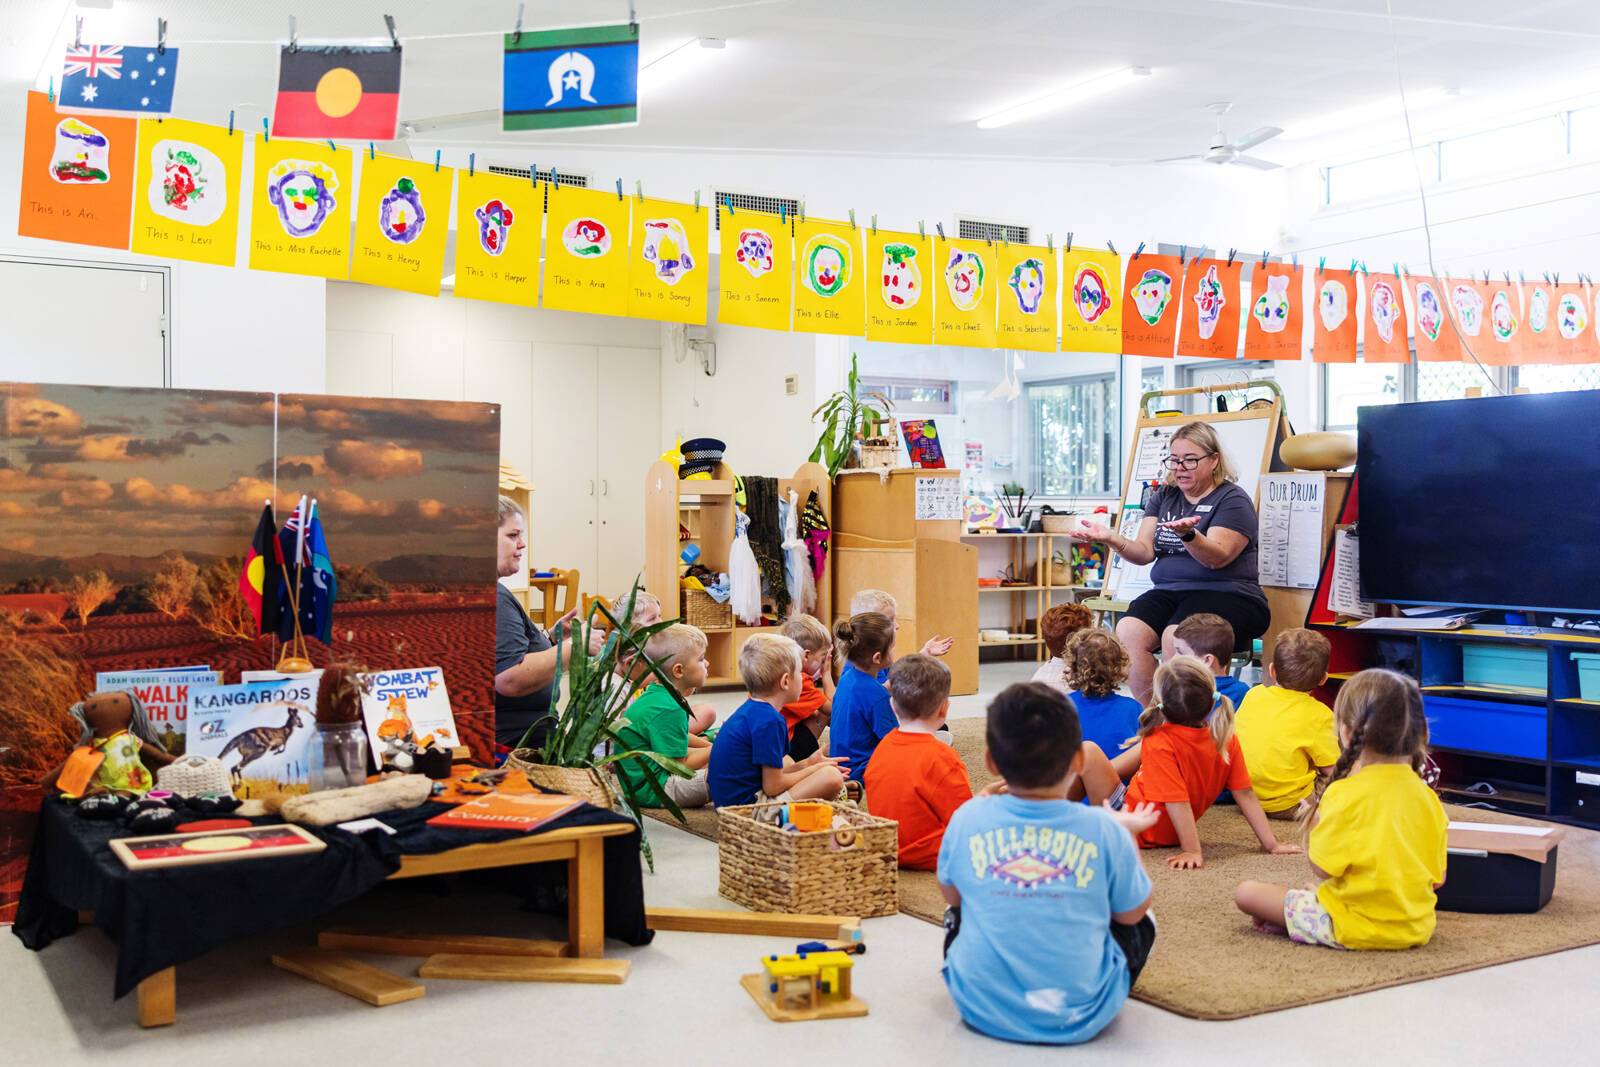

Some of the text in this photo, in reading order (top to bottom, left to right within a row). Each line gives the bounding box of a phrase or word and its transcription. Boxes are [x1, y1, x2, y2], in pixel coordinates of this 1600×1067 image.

[30, 201, 53, 214] This
[62, 207, 71, 216] is
[146, 226, 168, 239] This
[191, 232, 212, 245] Levi
[256, 240, 271, 251] This
[276, 244, 283, 252] is
[363, 247, 381, 258] This
[398, 252, 420, 272] Henry
[464, 266, 484, 277] This
[553, 275, 570, 285] This
[634, 288, 652, 298] This
[670, 291, 691, 307] Sonny
[725, 290, 740, 300] This
[796, 308, 812, 318] This
[872, 315, 884, 326] This
[1269, 481, 1318, 502] OUR DRUM
[194, 687, 311, 709] KANGAROOS
[968, 825, 1098, 889] BILLABONG
